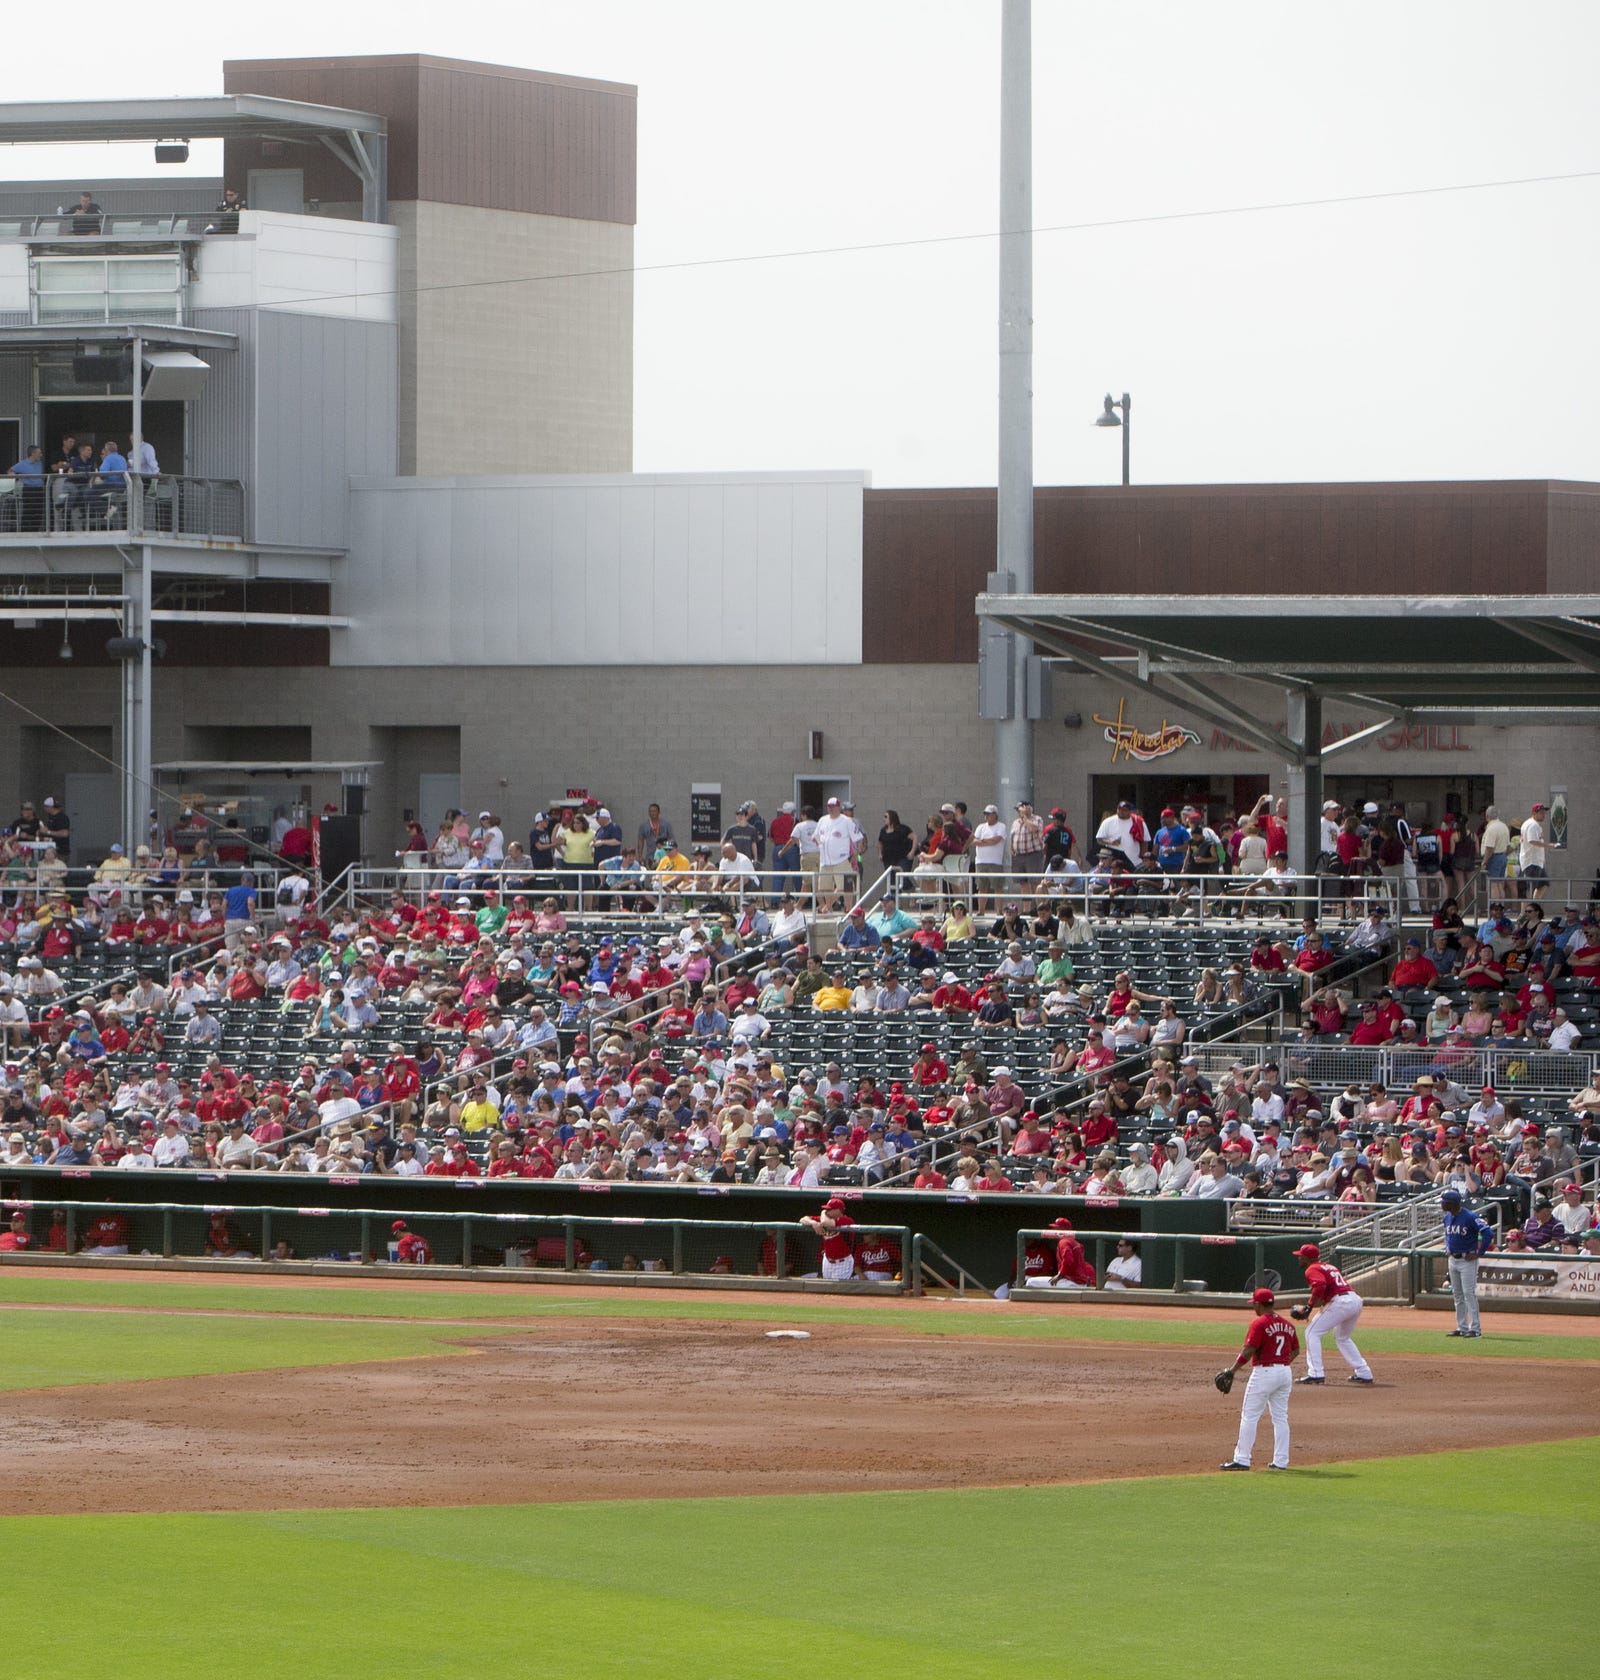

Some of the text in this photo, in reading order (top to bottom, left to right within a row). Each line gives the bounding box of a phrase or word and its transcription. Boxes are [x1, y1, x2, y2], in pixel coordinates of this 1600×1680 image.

[862, 1248, 889, 1264] Reds
[1570, 1283, 1596, 1293] AND
[1275, 1335, 1285, 1356] 7
